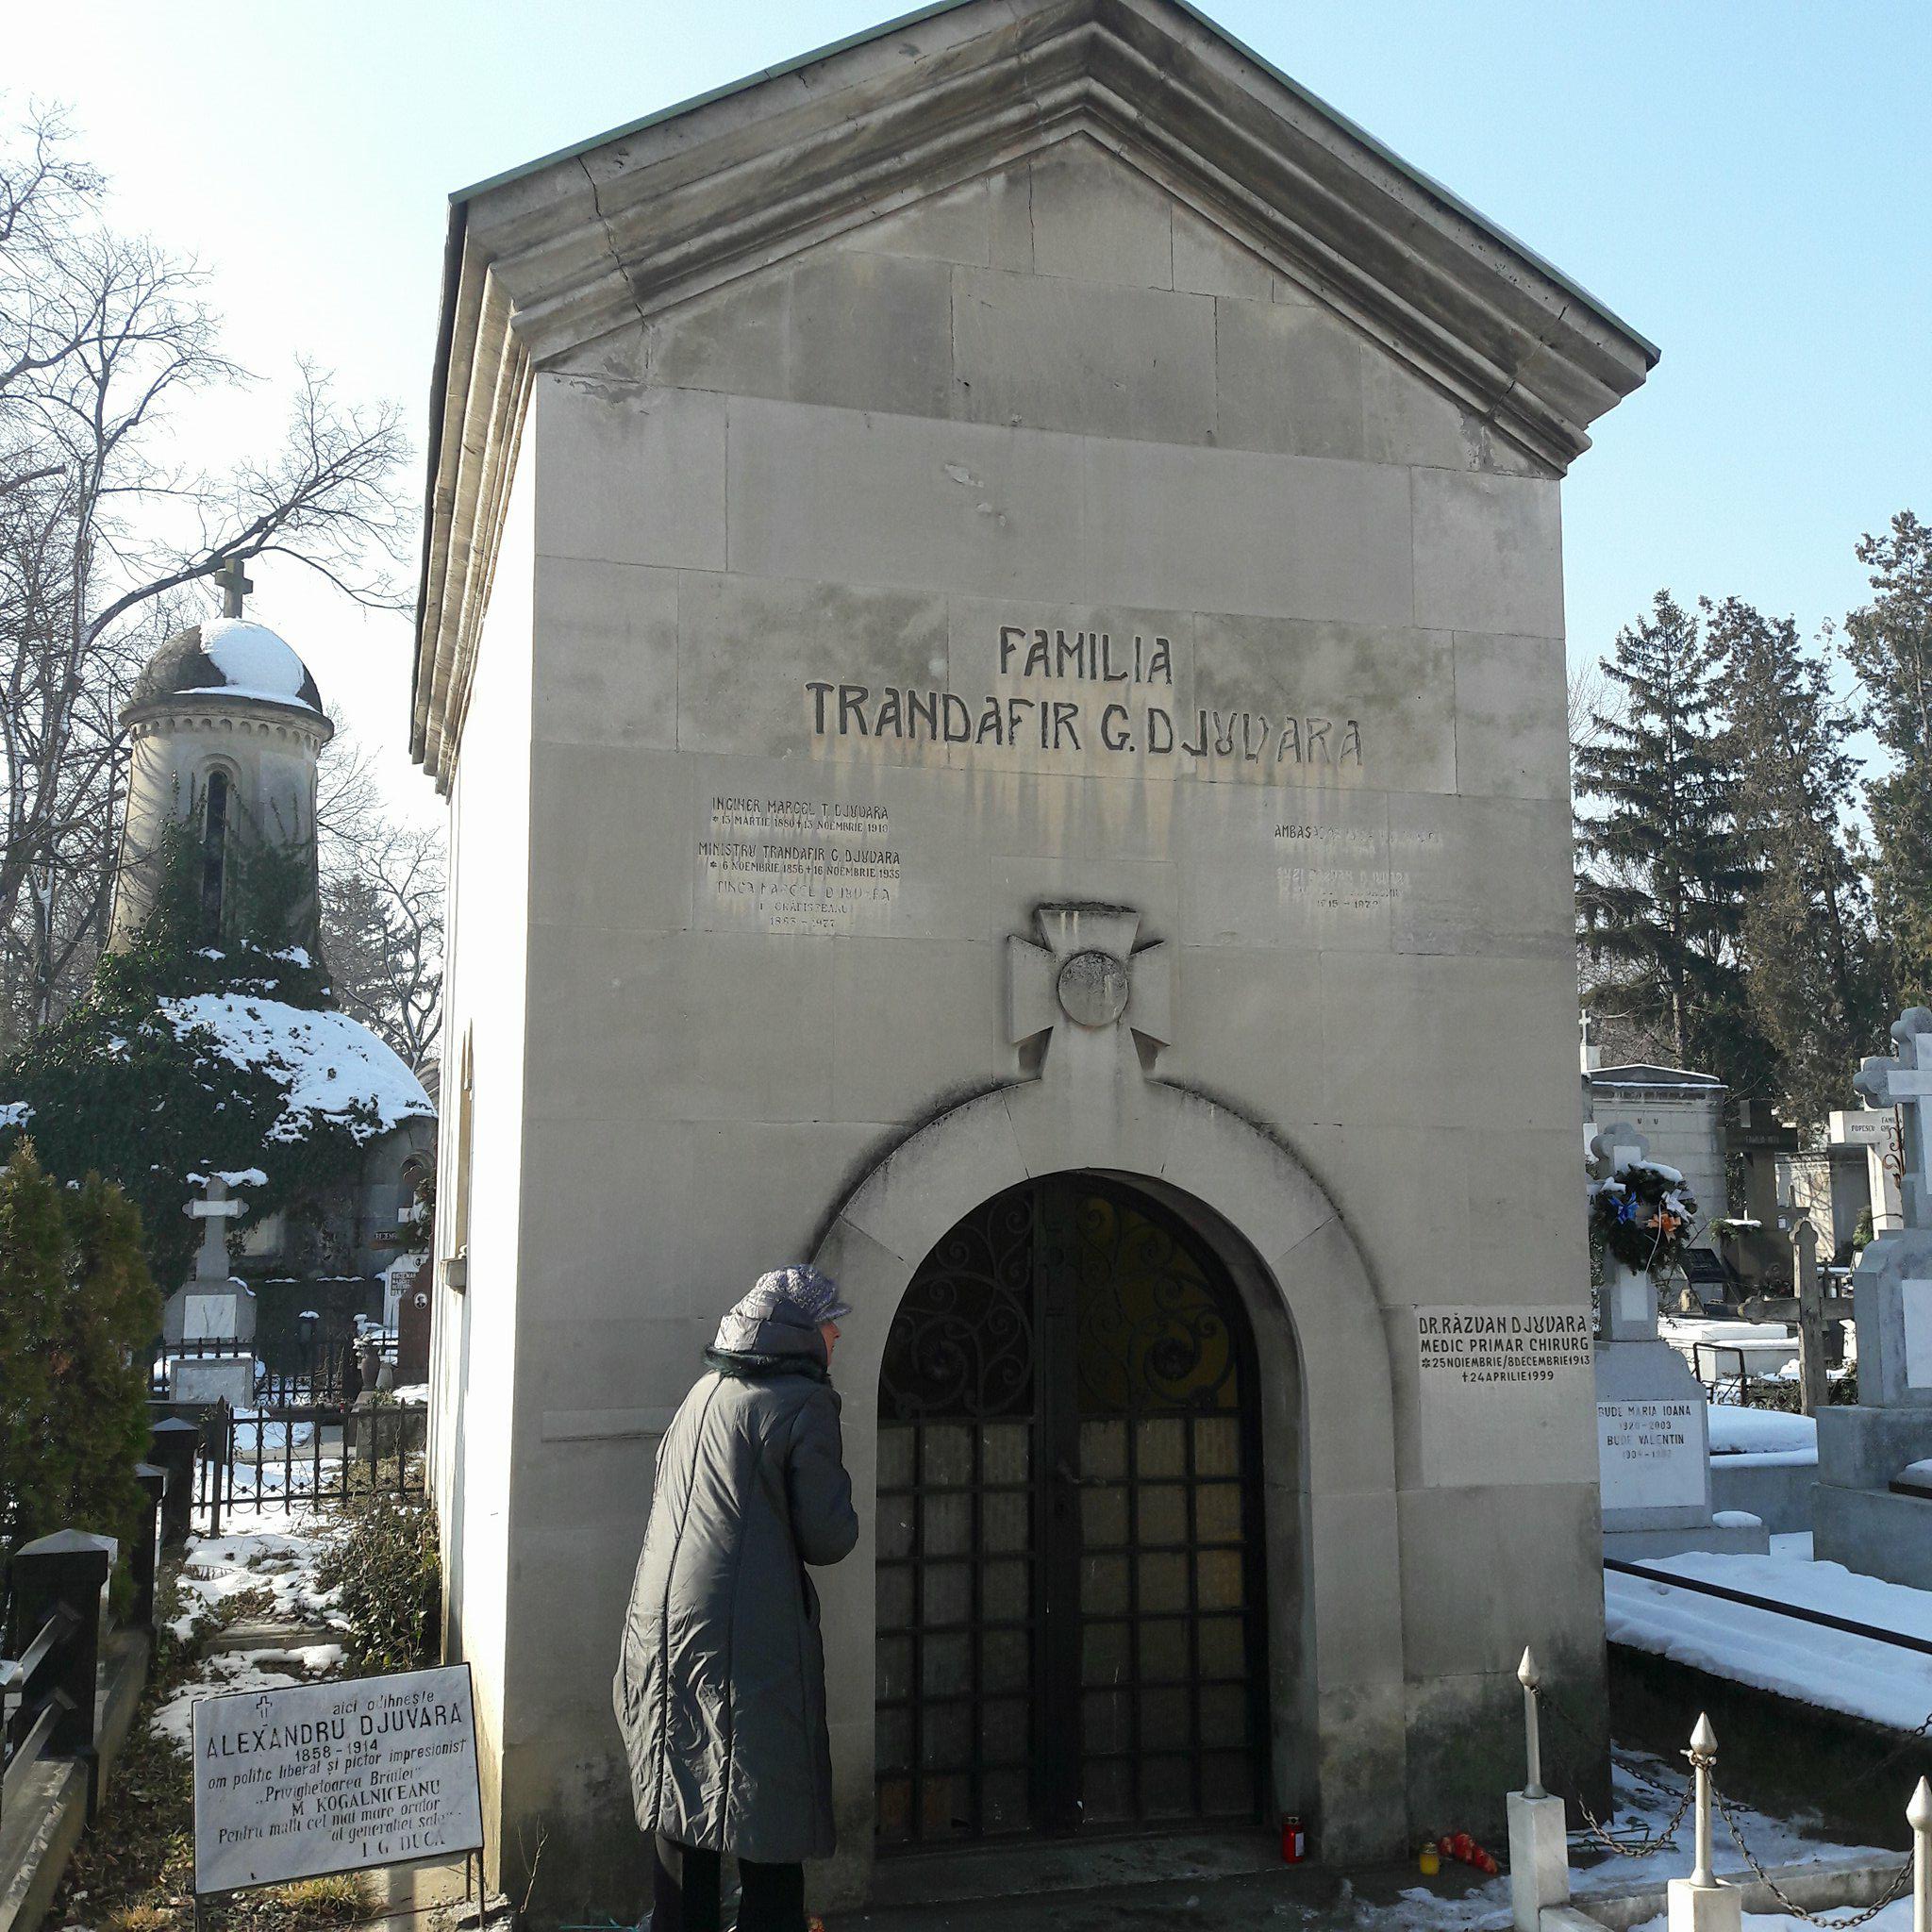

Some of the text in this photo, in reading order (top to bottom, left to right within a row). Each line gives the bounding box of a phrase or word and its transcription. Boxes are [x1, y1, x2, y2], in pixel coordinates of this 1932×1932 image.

[1000, 625, 1174, 686] FAMILIA
[805, 681, 1081, 751] TRANDAFIR
[1147, 706, 1364, 767] DJUVARA
[712, 797, 760, 813] INGINER
[767, 800, 816, 816] MARCEL
[734, 816, 771, 827] MARTIE
[817, 821, 863, 832] NOEMBRIE
[698, 841, 757, 858] MINISTRU
[762, 844, 825, 861] TRANDAFIR
[731, 861, 780, 873] NOEMBRIE
[826, 866, 876, 878] NOEMBRIE
[1512, 1316, 1588, 1334] DJUVARA
[1421, 1337, 1589, 1353] MEDIC PRIMAR CHIRURG
[1662, 1405, 1691, 1416] IOANA
[333, 1699, 358, 1715] aici
[207, 1703, 463, 1759] ALEXANDRU DJUVARA
[208, 1776, 227, 1790] om
[233, 1767, 273, 1790] politic
[279, 1760, 321, 1779] liberal
[344, 1753, 382, 1774] pictor
[389, 1739, 468, 1765] impresionist
